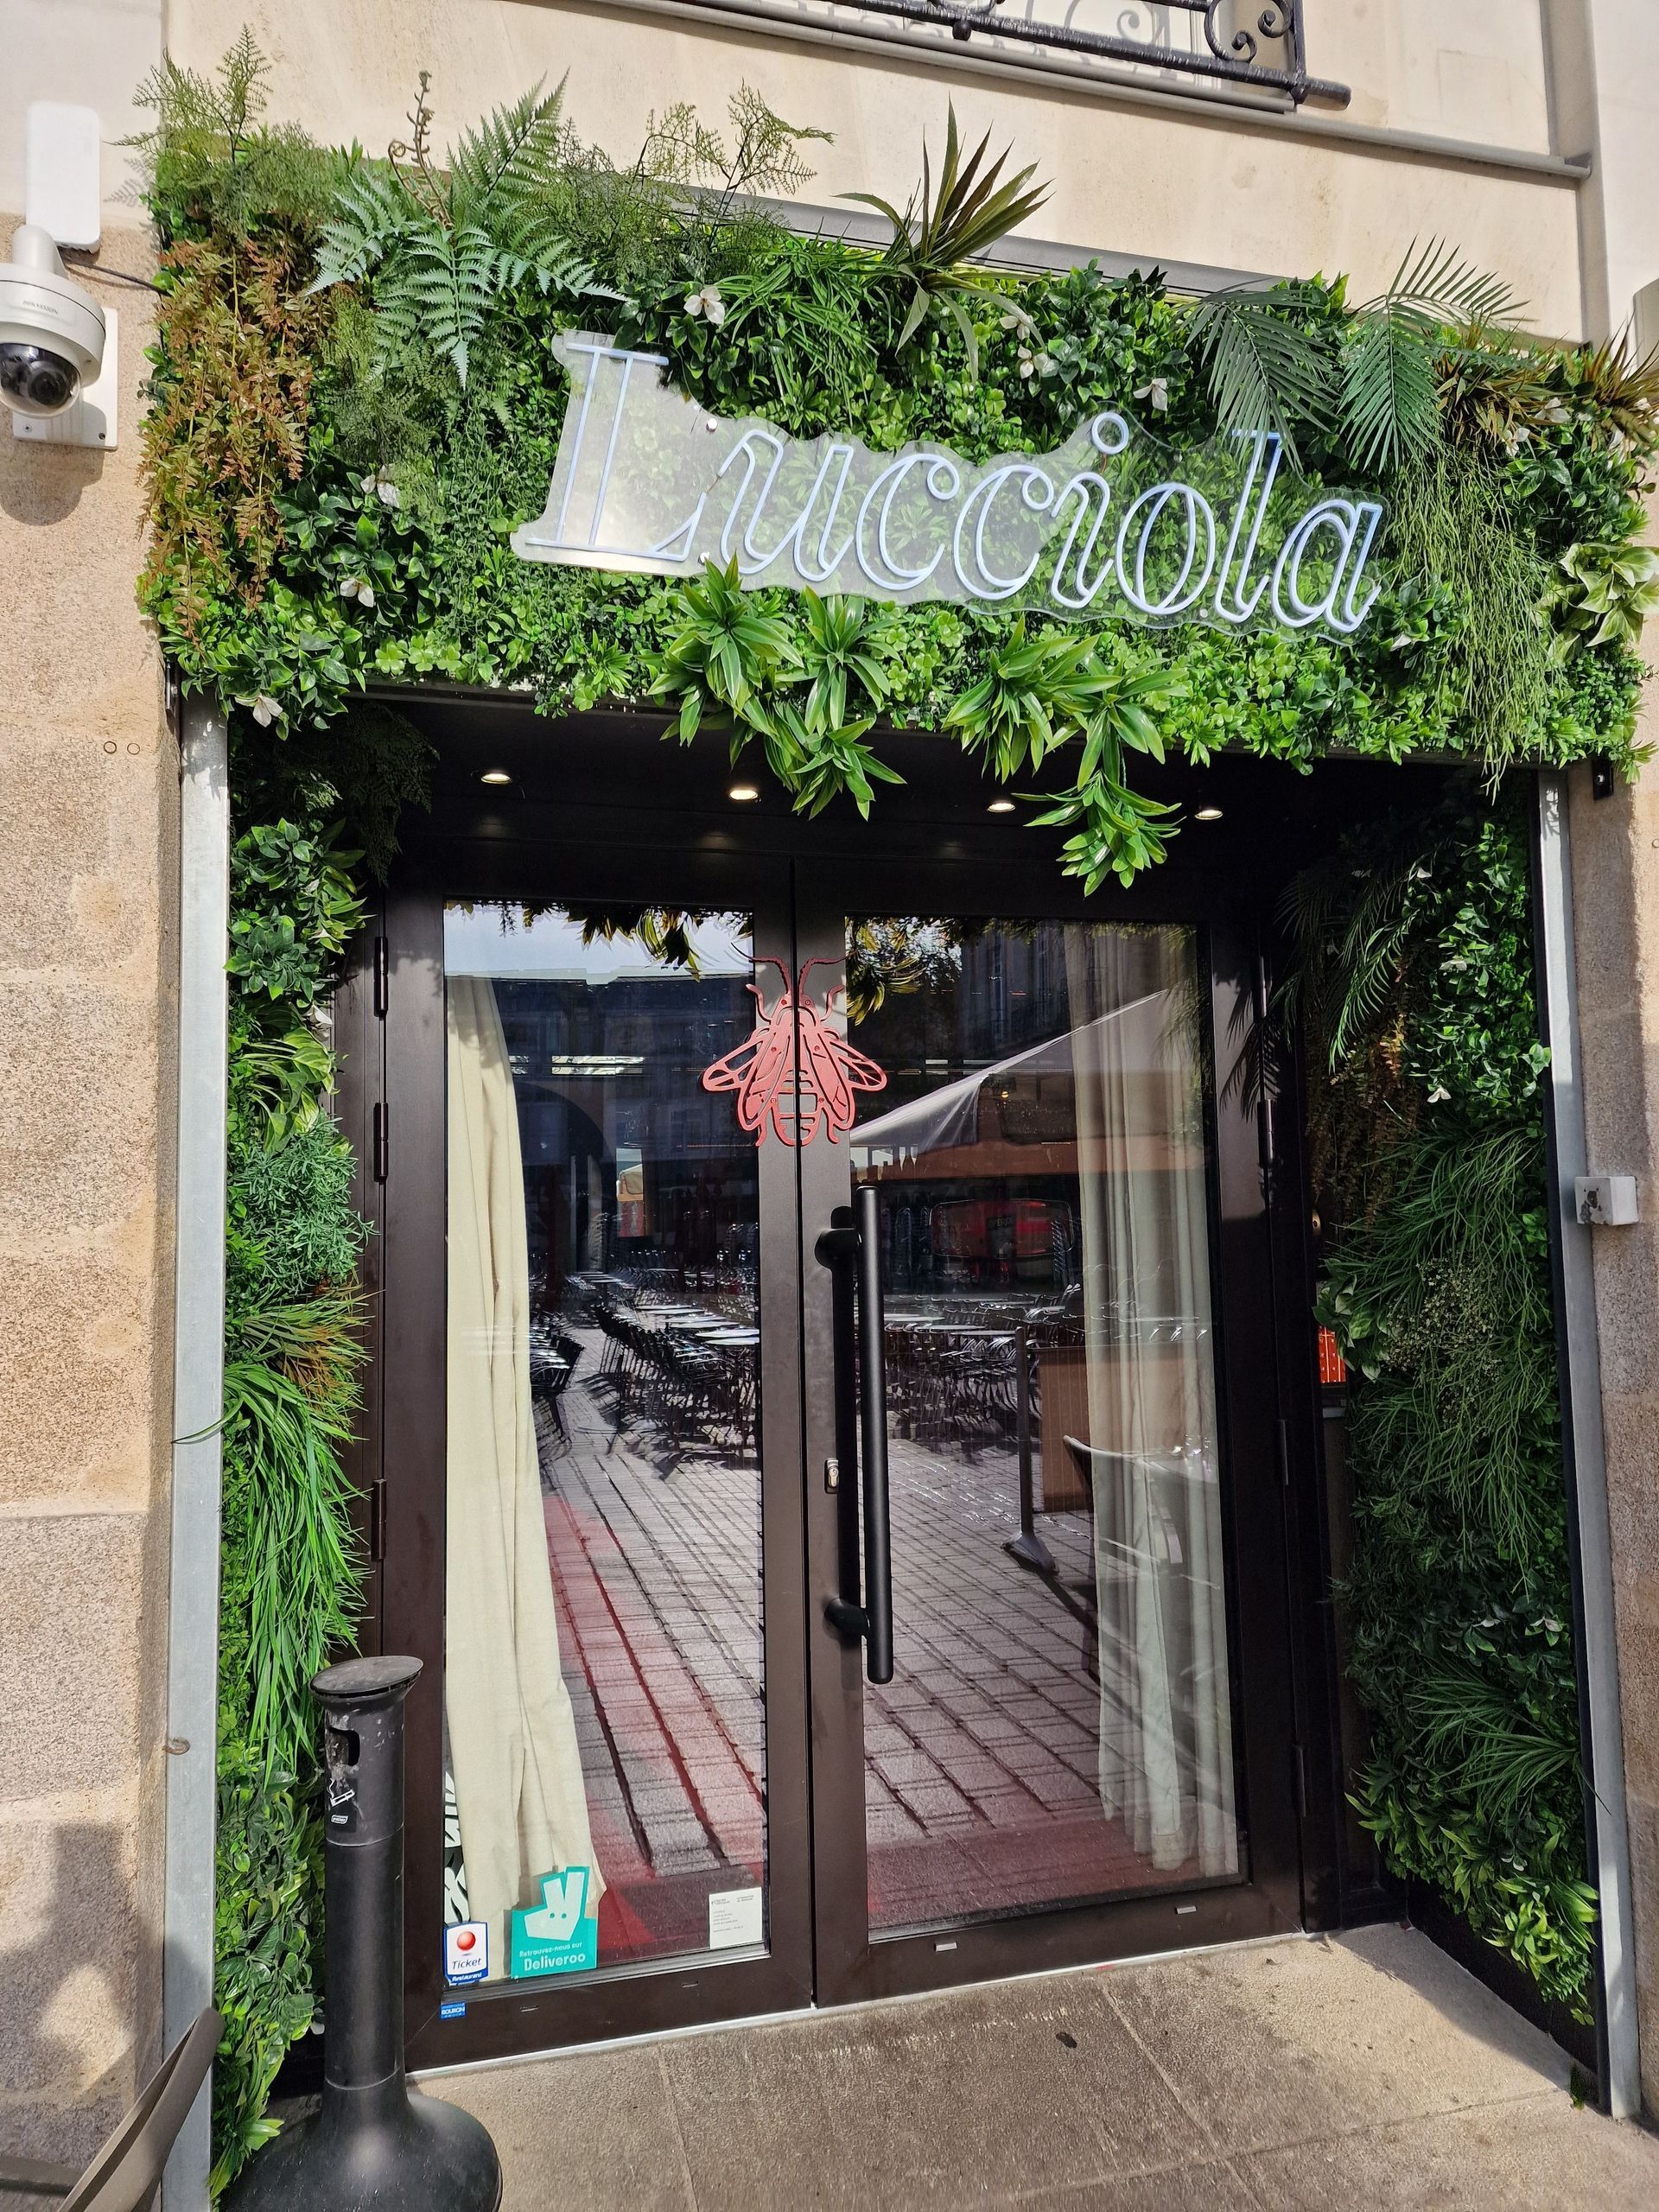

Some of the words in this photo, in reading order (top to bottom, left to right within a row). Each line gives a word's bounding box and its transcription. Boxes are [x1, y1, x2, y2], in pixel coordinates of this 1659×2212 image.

[525, 344, 1381, 632] Lucciola
[518, 1942, 570, 1957] Retrouvez-nous
[452, 1958, 481, 1969] Ticket
[524, 1953, 586, 1972] Deliveroo
[452, 1972, 482, 1982] Restaurant
